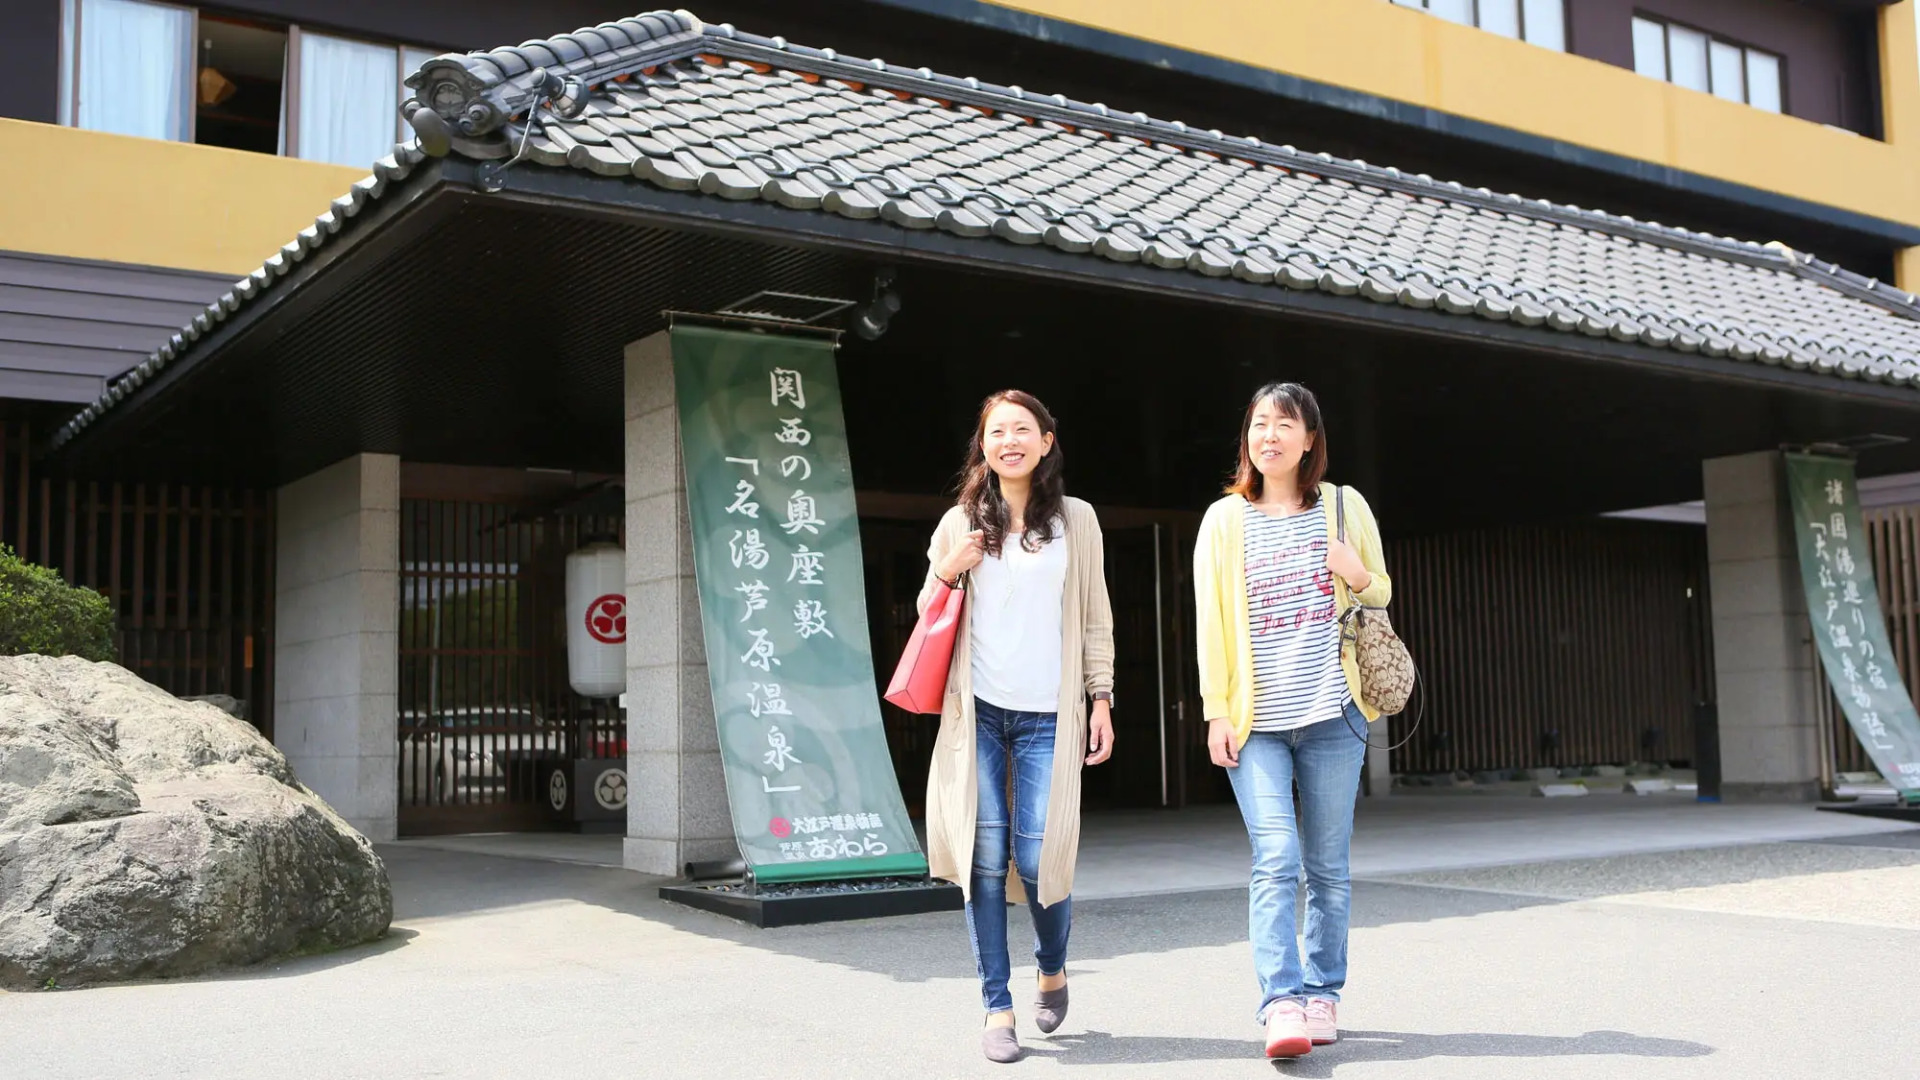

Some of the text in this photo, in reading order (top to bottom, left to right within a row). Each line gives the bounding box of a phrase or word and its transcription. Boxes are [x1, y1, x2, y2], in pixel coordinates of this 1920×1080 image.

[769, 366, 835, 640] 関西の奥座敷
[1258, 614, 1287, 634] The
[805, 833, 888, 859] あわら
